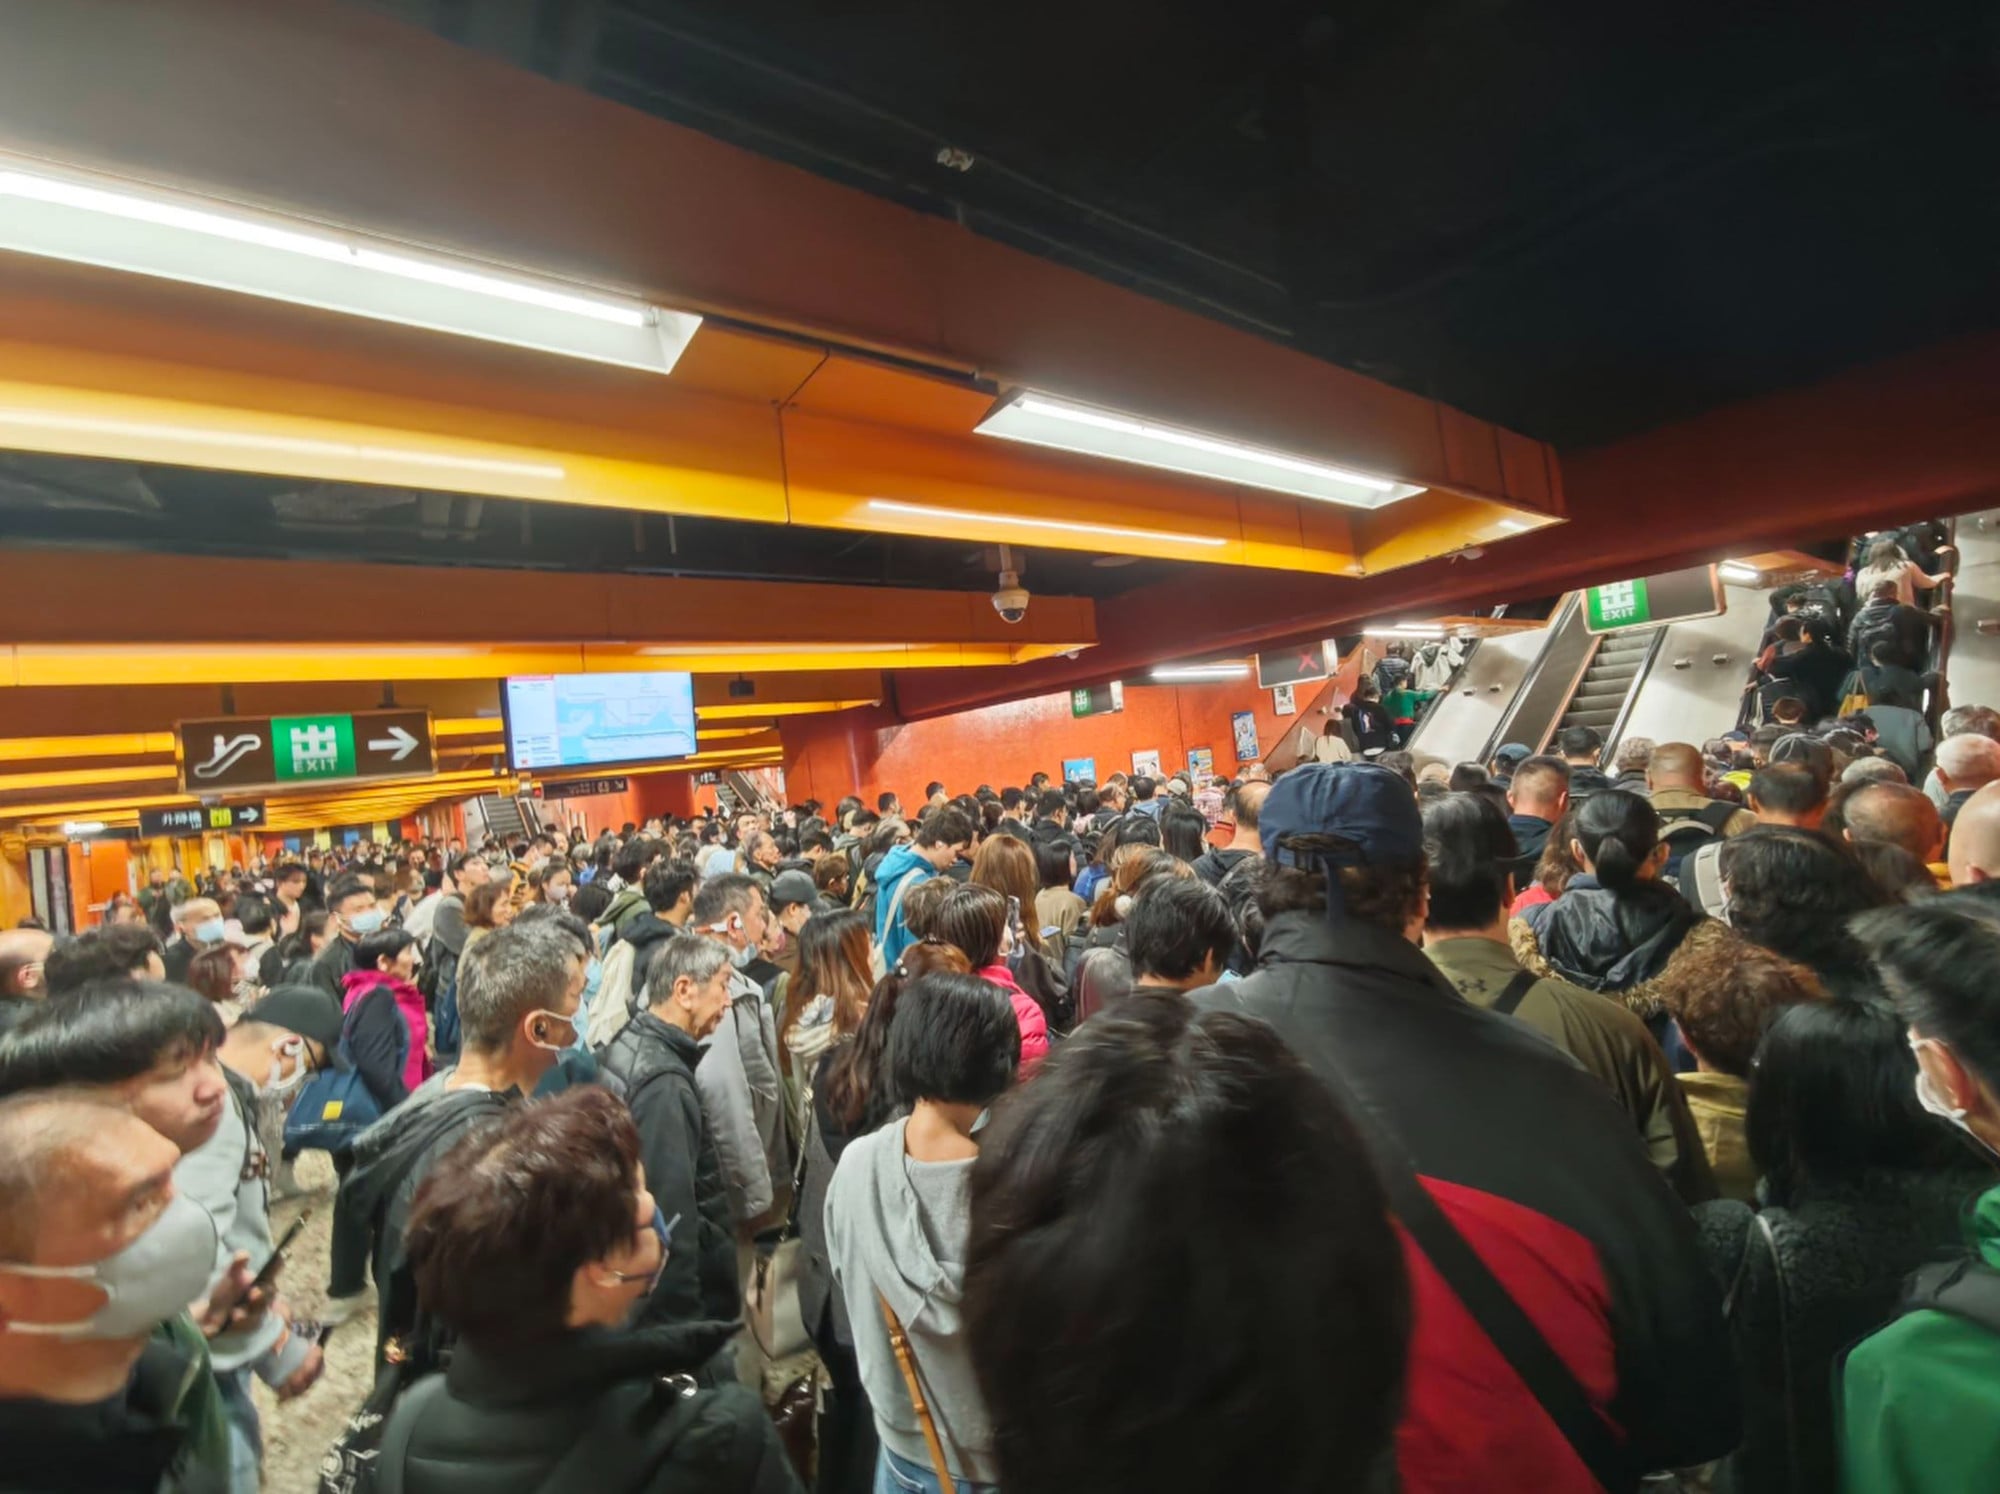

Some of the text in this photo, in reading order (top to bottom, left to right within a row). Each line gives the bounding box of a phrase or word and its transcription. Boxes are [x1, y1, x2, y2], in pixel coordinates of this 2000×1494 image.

[1601, 607, 1635, 622] EXIT
[290, 725, 338, 759] 出
[293, 758, 338, 774] EXIT
